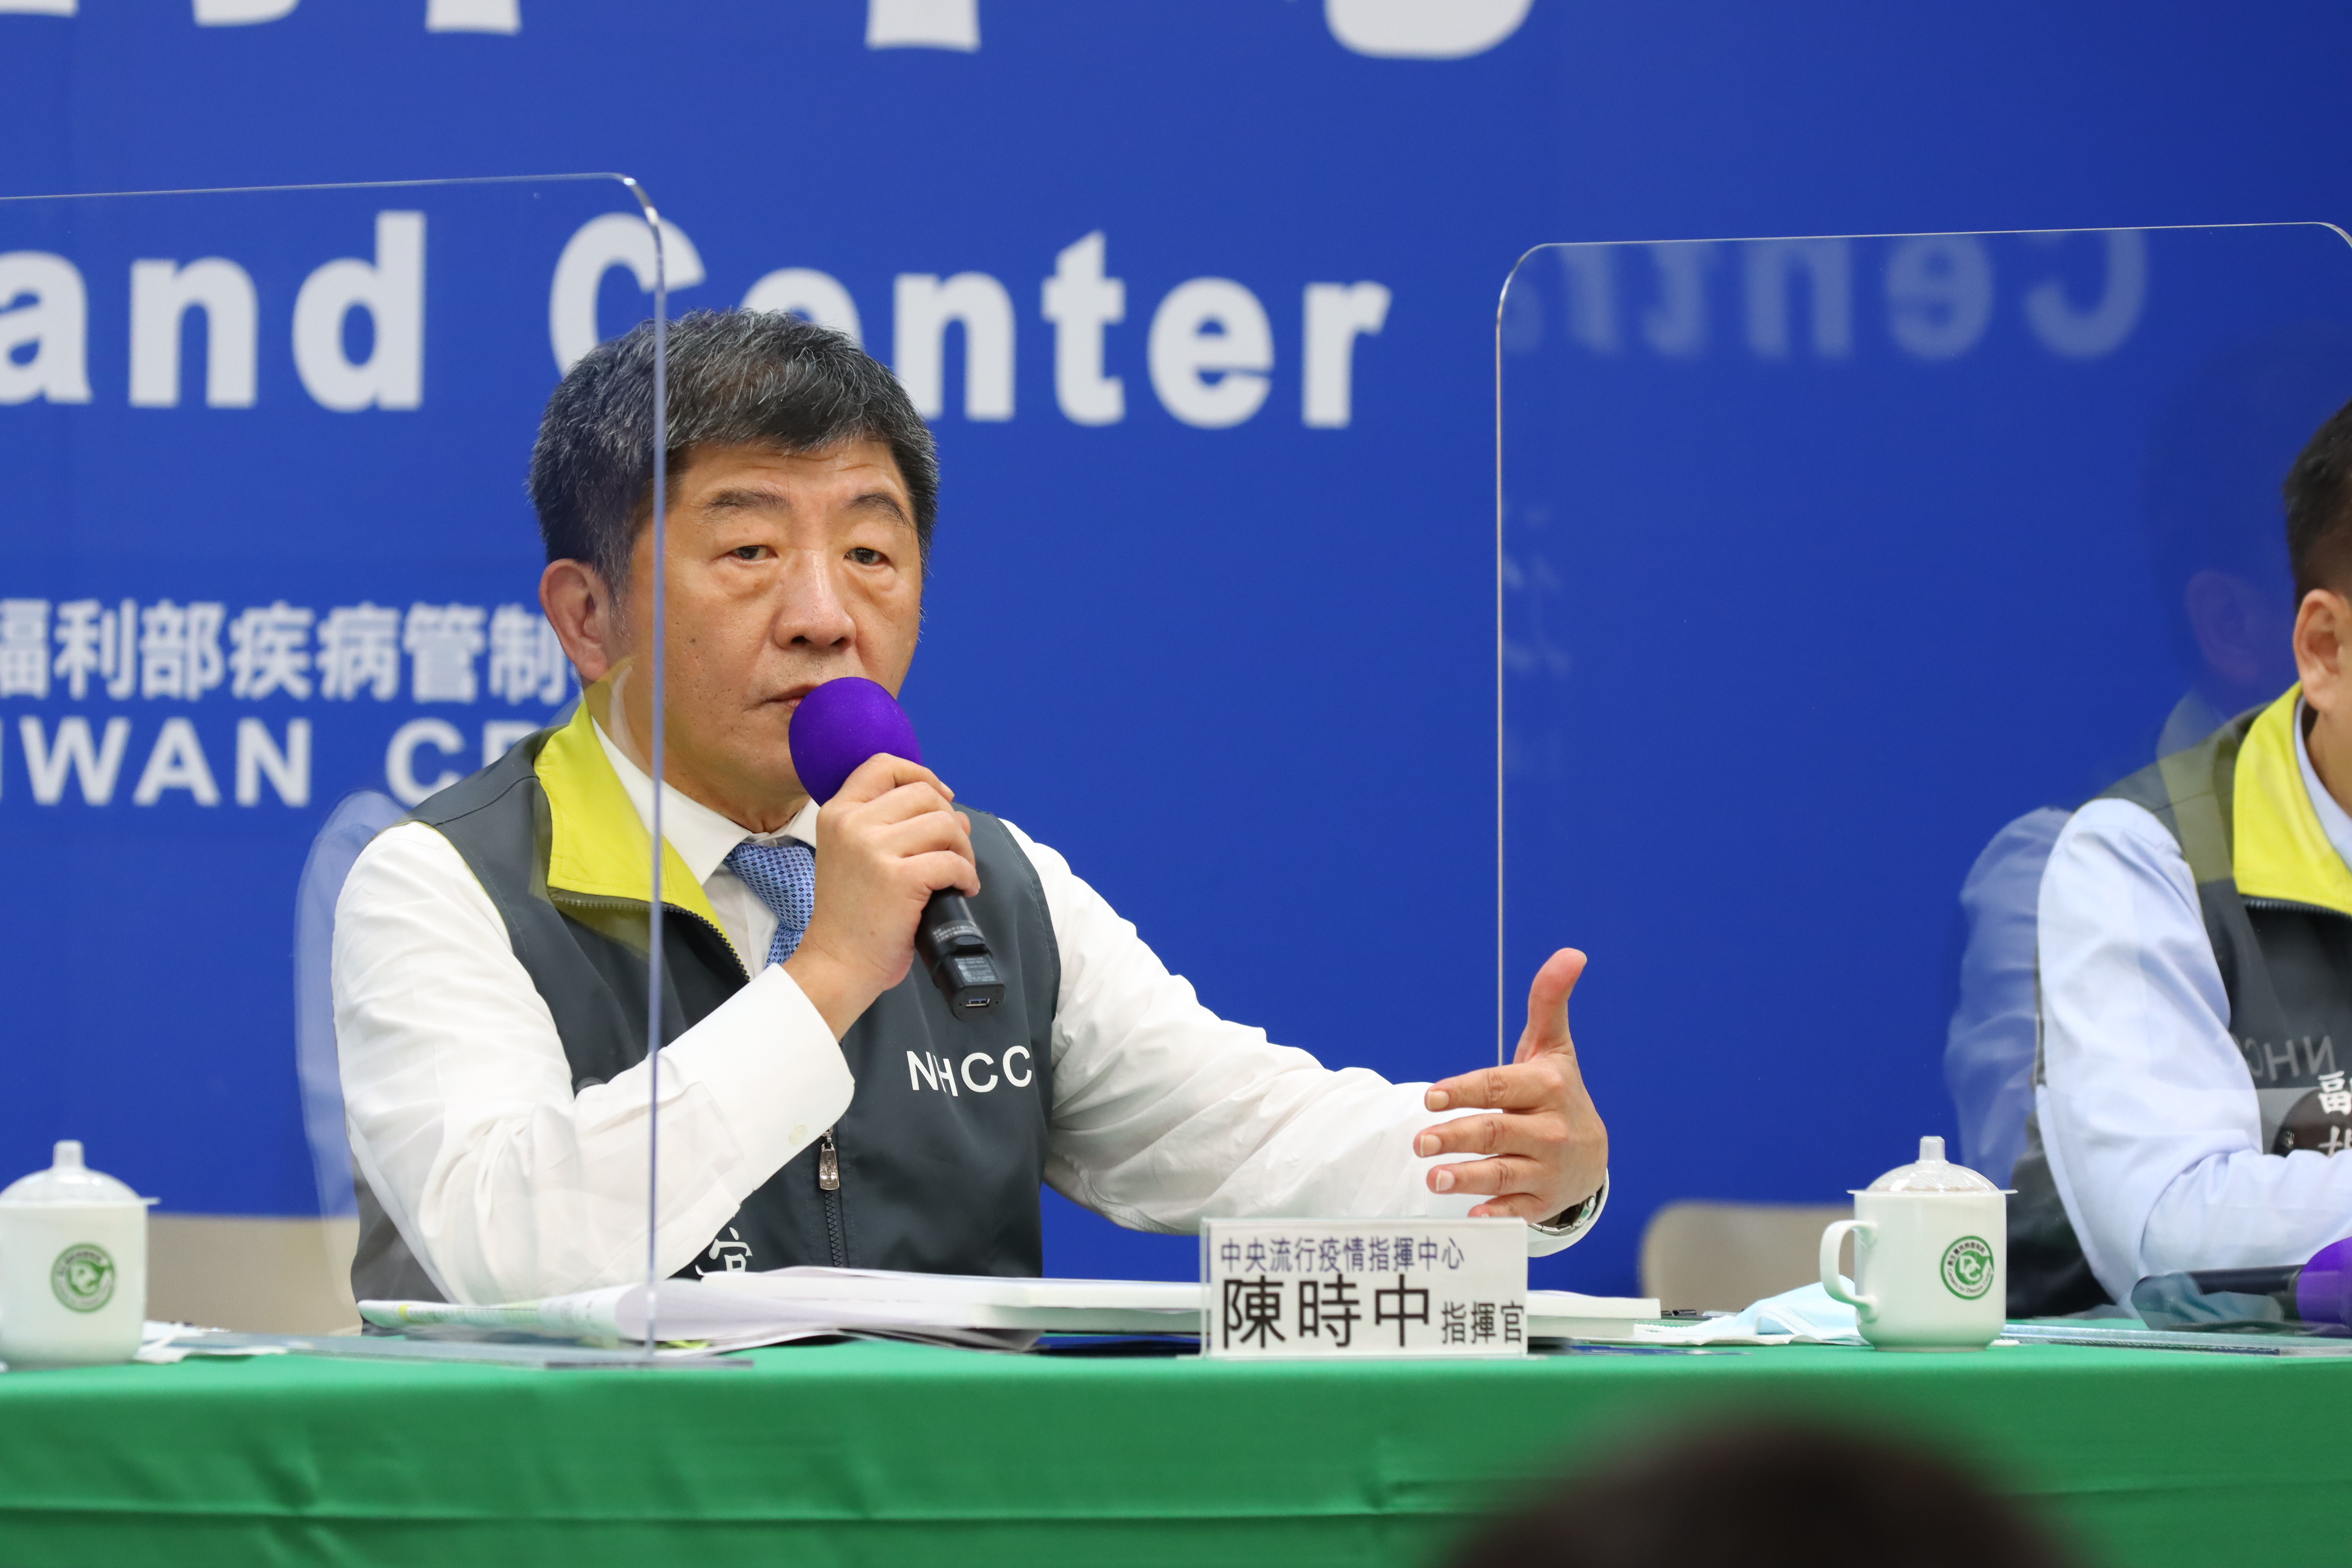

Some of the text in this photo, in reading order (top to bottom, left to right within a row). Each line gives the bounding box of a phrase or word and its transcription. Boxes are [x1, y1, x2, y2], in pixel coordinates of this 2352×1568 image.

[0, 598, 579, 706] 福利部疾病管制
[0, 715, 312, 807] WAN
[906, 1045, 1032, 1097] NHCC
[1220, 1236, 1465, 1273] 中央流行疫情指揮中心
[1223, 1273, 1525, 1349] 陳時中 指揮官
